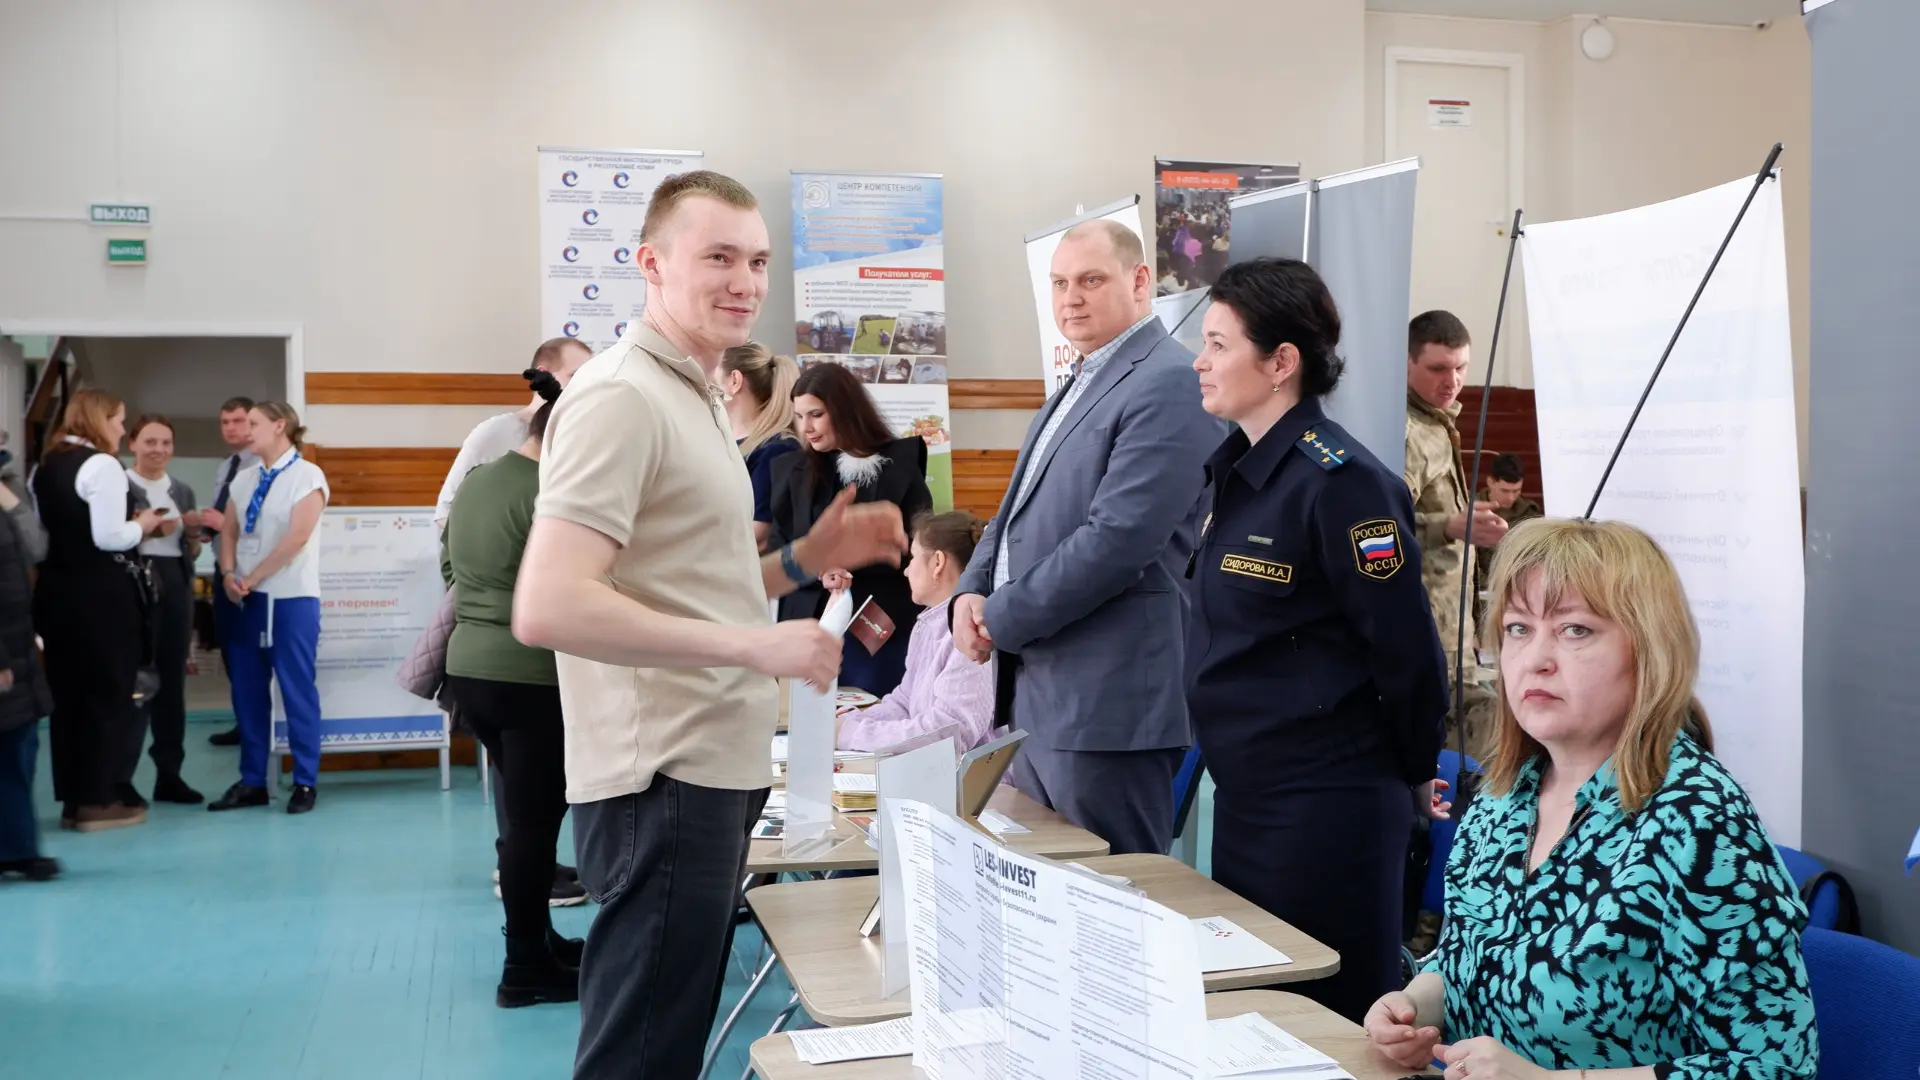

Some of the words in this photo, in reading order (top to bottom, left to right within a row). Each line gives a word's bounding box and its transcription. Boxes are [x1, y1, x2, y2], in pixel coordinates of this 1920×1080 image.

[837, 182, 862, 191] ЦЕНТР
[864, 182, 922, 192] КОМПЕТЕНЦИЙ
[94, 207, 147, 221] ВЫХОД
[864, 269, 909, 280] Получатели
[910, 271, 932, 280] услуг:
[1354, 523, 1395, 540] РОССИЯ
[1225, 558, 1266, 574] СИДОРОВА
[1267, 567, 1287, 578] И.А.
[1364, 557, 1399, 573] ФССП
